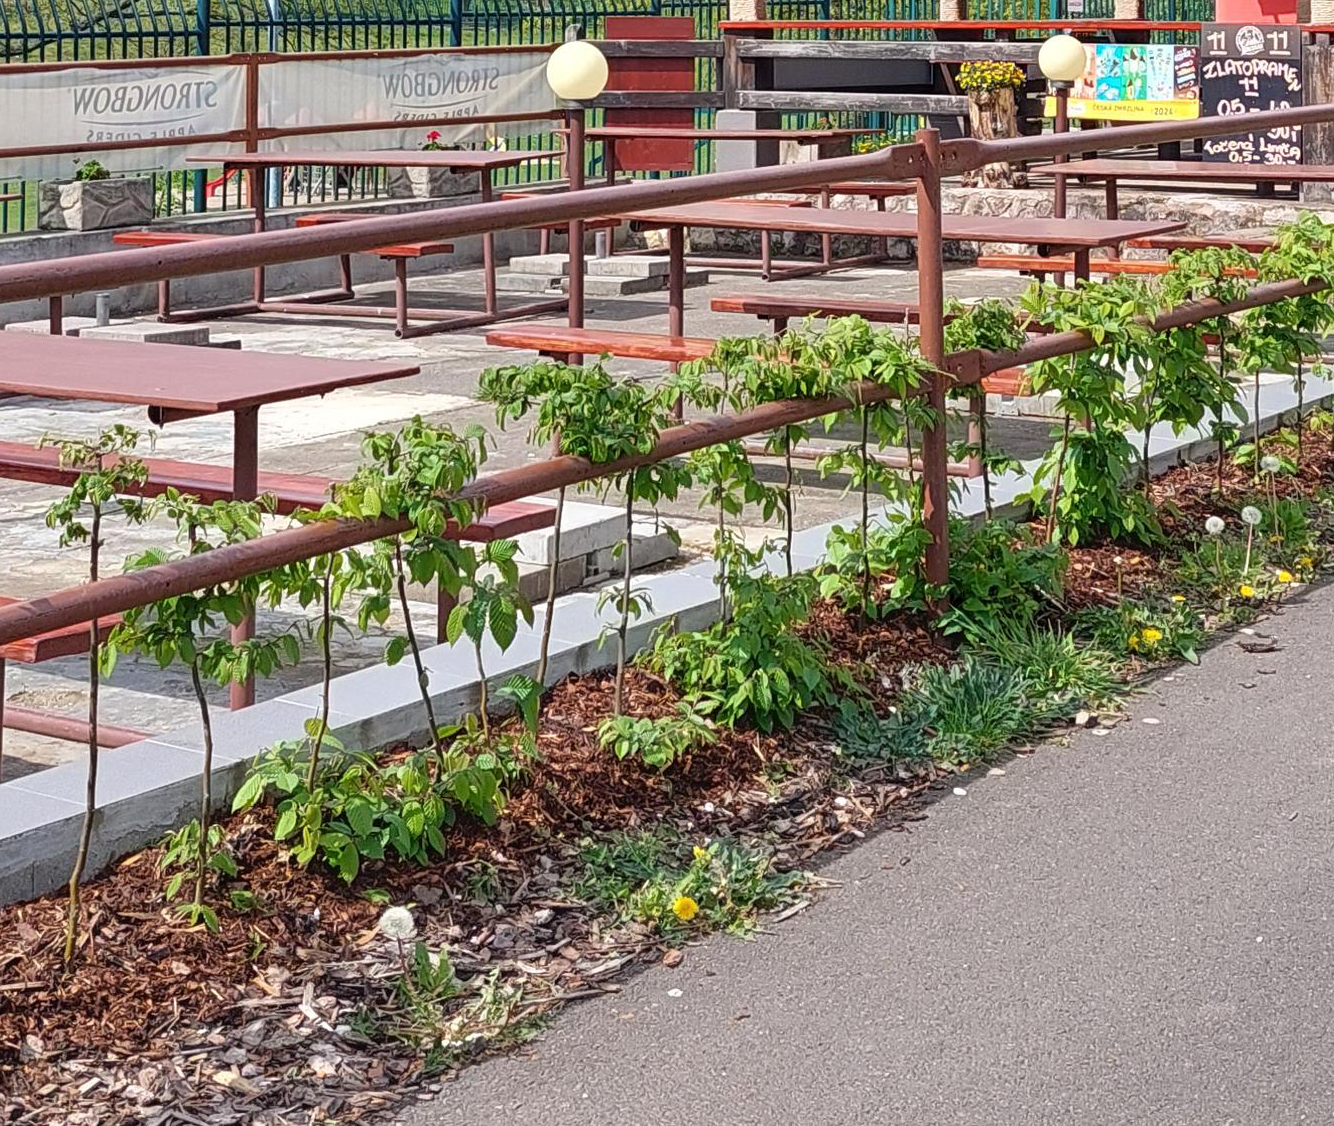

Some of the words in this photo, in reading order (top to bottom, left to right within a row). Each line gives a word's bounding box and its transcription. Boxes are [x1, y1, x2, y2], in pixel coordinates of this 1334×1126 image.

[1207, 31, 1226, 51] 11
[1267, 31, 1289, 51] 11
[1202, 59, 1301, 91] ZLATOPRAMEN
[1154, 107, 1174, 115] 2024
